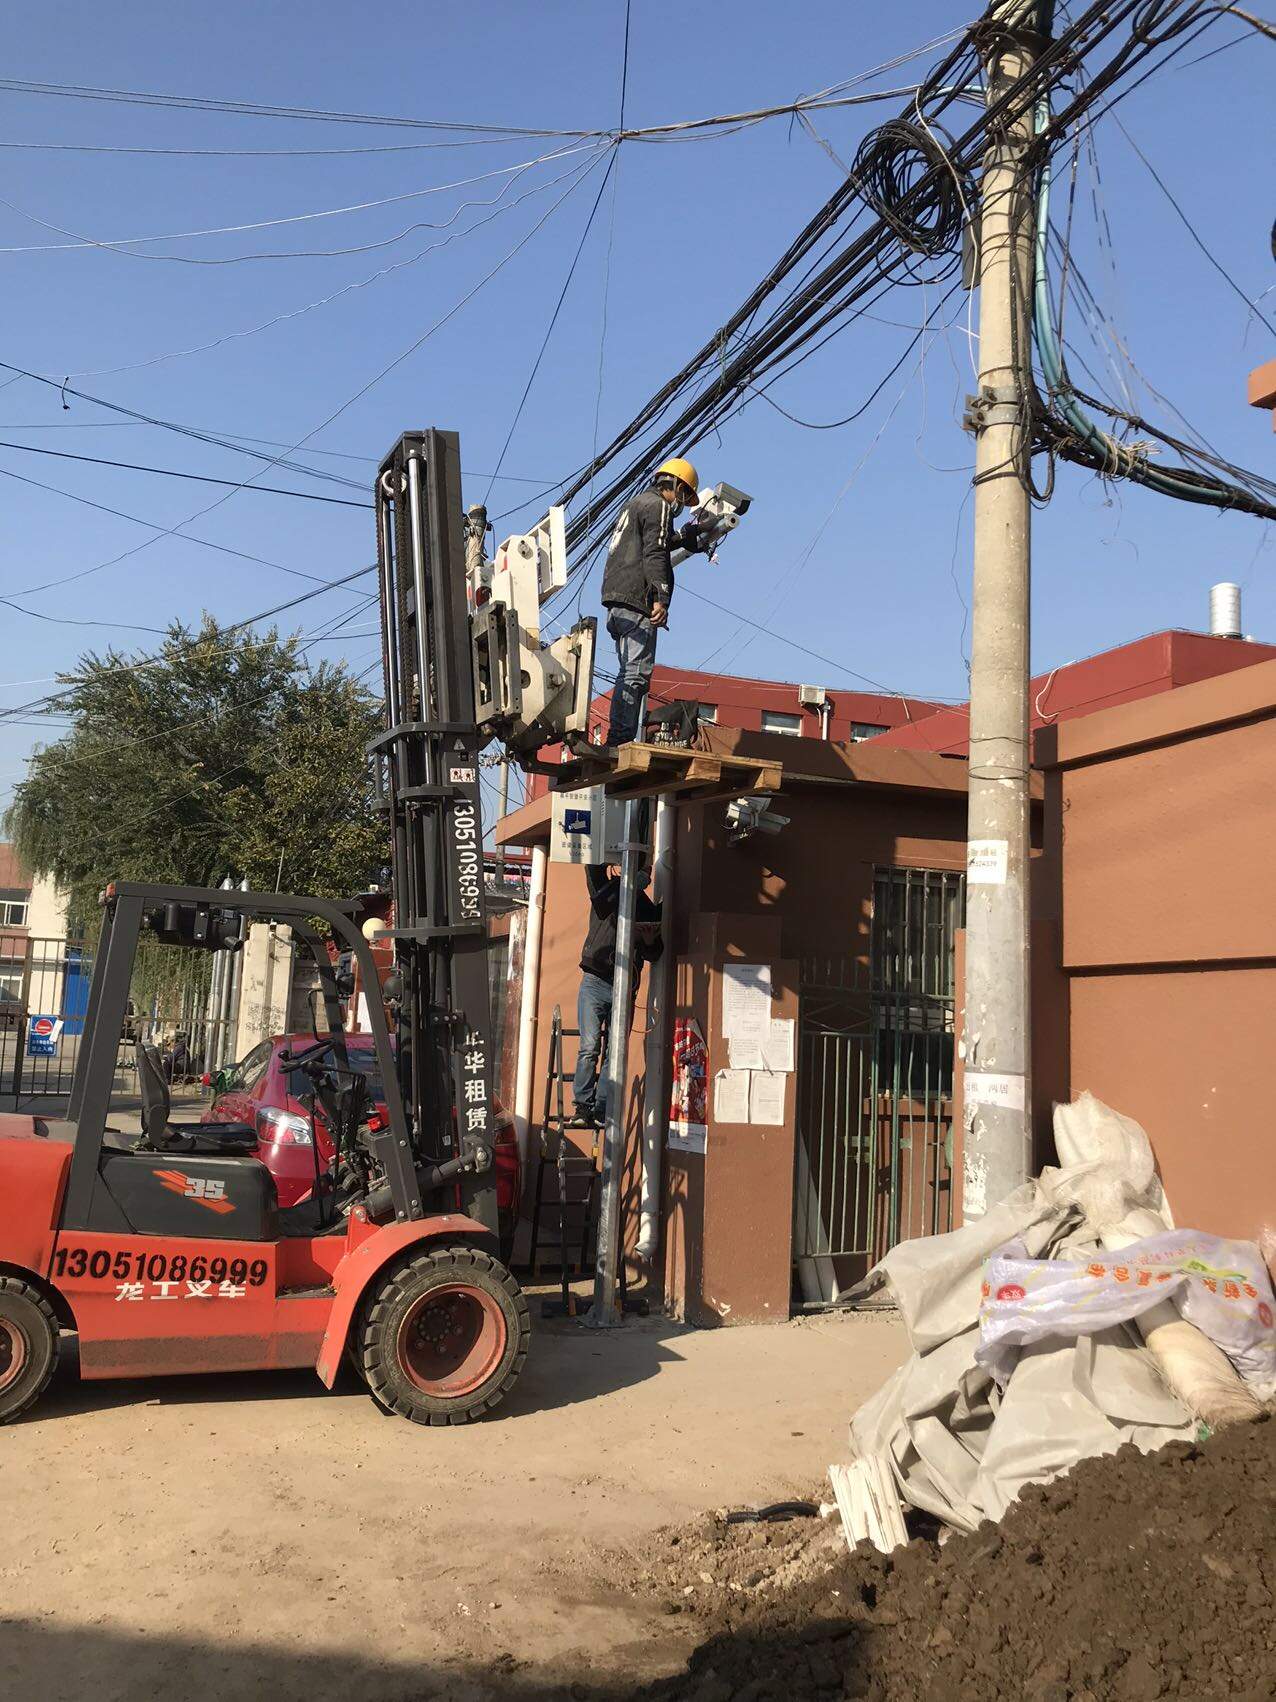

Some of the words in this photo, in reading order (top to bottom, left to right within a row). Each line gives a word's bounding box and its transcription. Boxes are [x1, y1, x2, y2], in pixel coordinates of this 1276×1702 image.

[184, 1178, 225, 1199] 35
[55, 1248, 268, 1287] 13051086999
[115, 1280, 247, 1301] 龙工叉车
